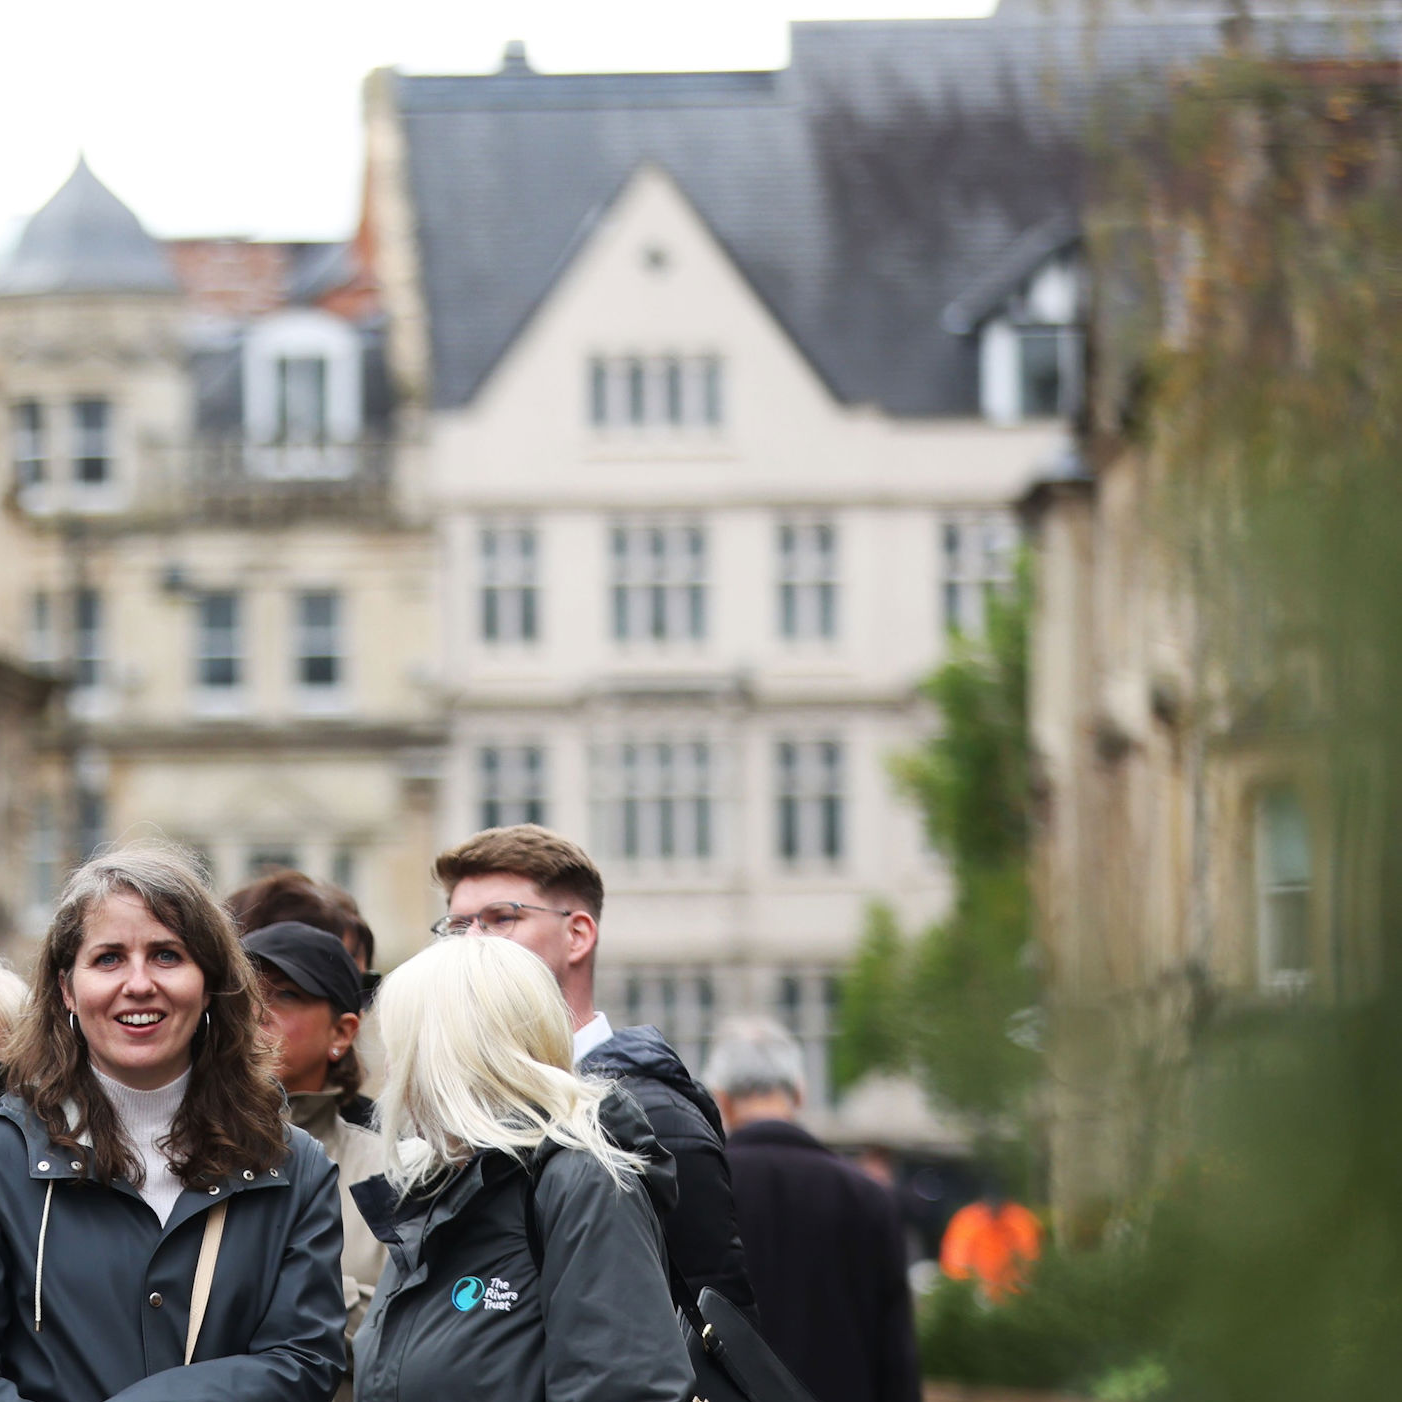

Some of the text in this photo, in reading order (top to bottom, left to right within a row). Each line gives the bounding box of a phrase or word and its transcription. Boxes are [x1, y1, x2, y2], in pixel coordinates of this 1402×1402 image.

[490, 1277, 510, 1290] The
[485, 1287, 519, 1301] Rivers
[483, 1298, 512, 1312] Trust
